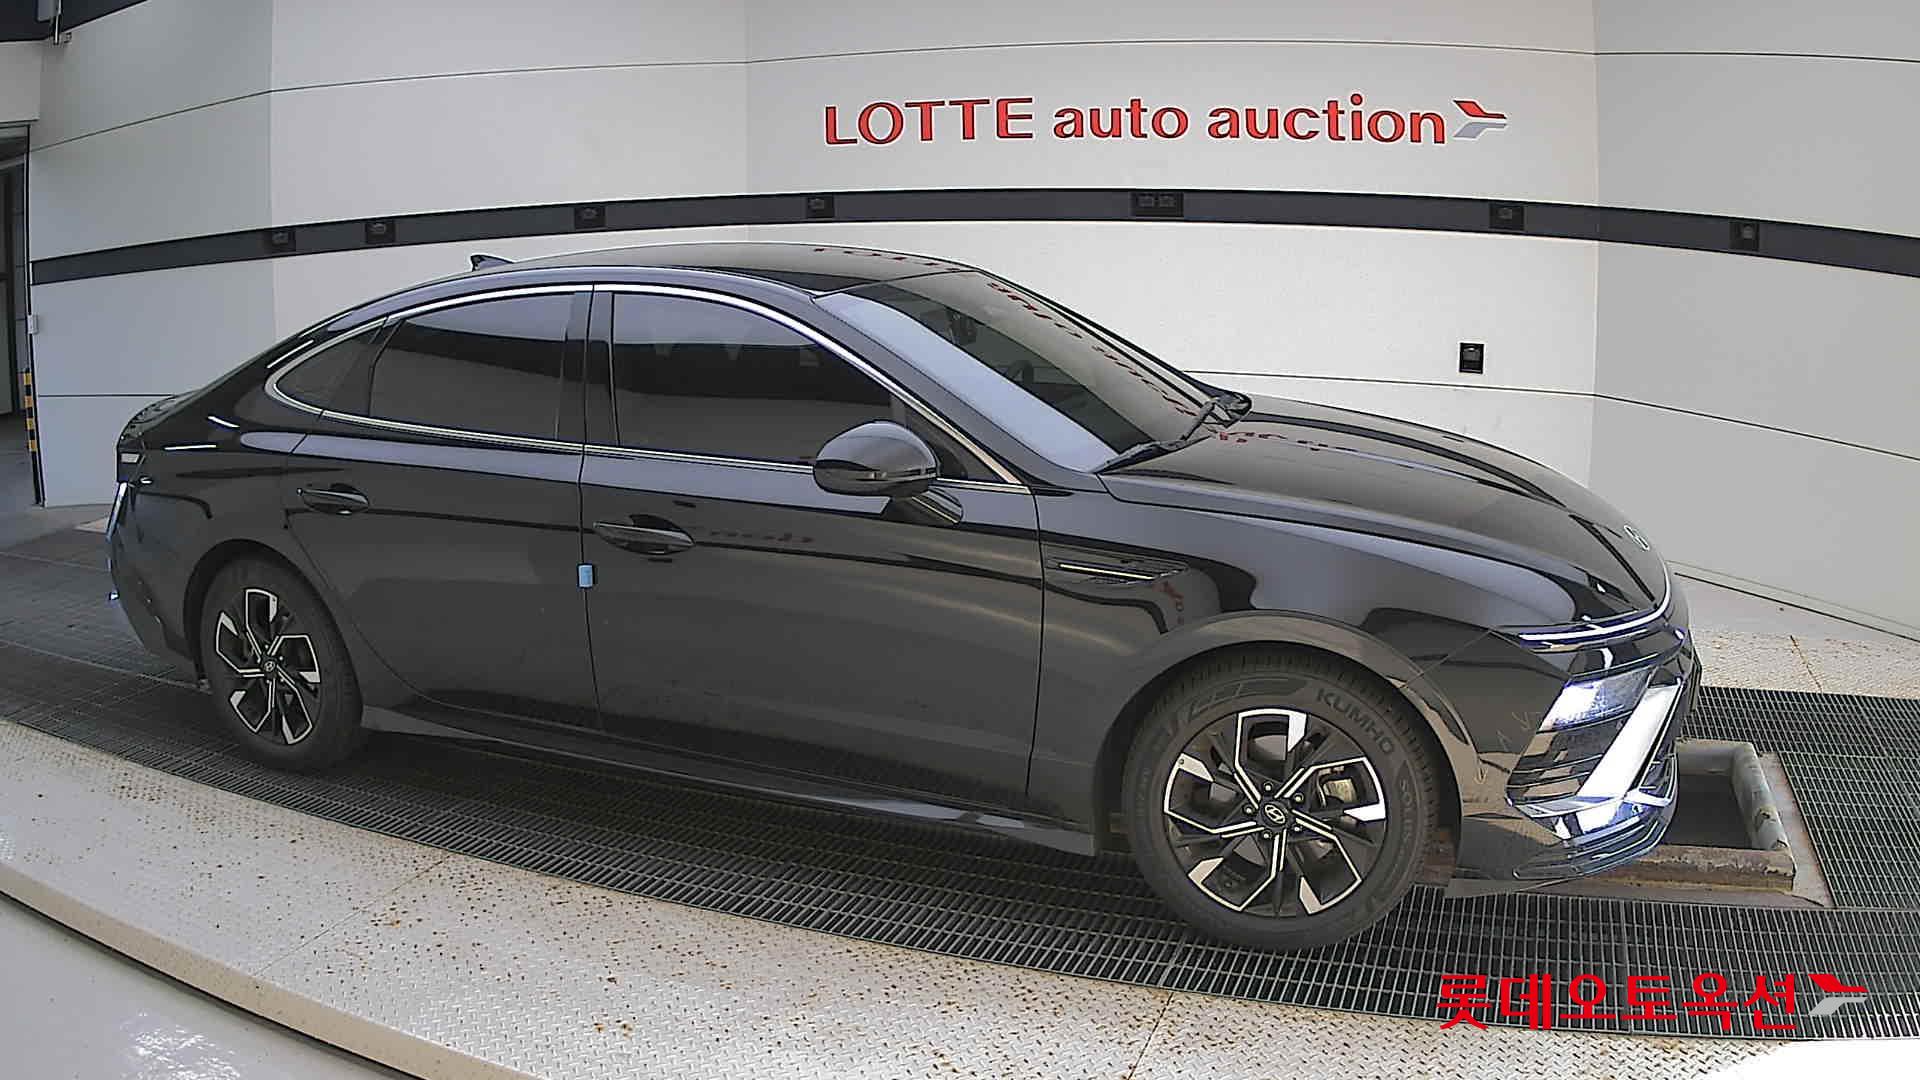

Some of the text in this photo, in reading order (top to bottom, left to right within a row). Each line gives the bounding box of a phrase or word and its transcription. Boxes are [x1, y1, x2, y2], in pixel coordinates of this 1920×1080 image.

[825, 93, 1446, 145] LOTTE auto auction
[1316, 687, 1395, 754] KUMHO
